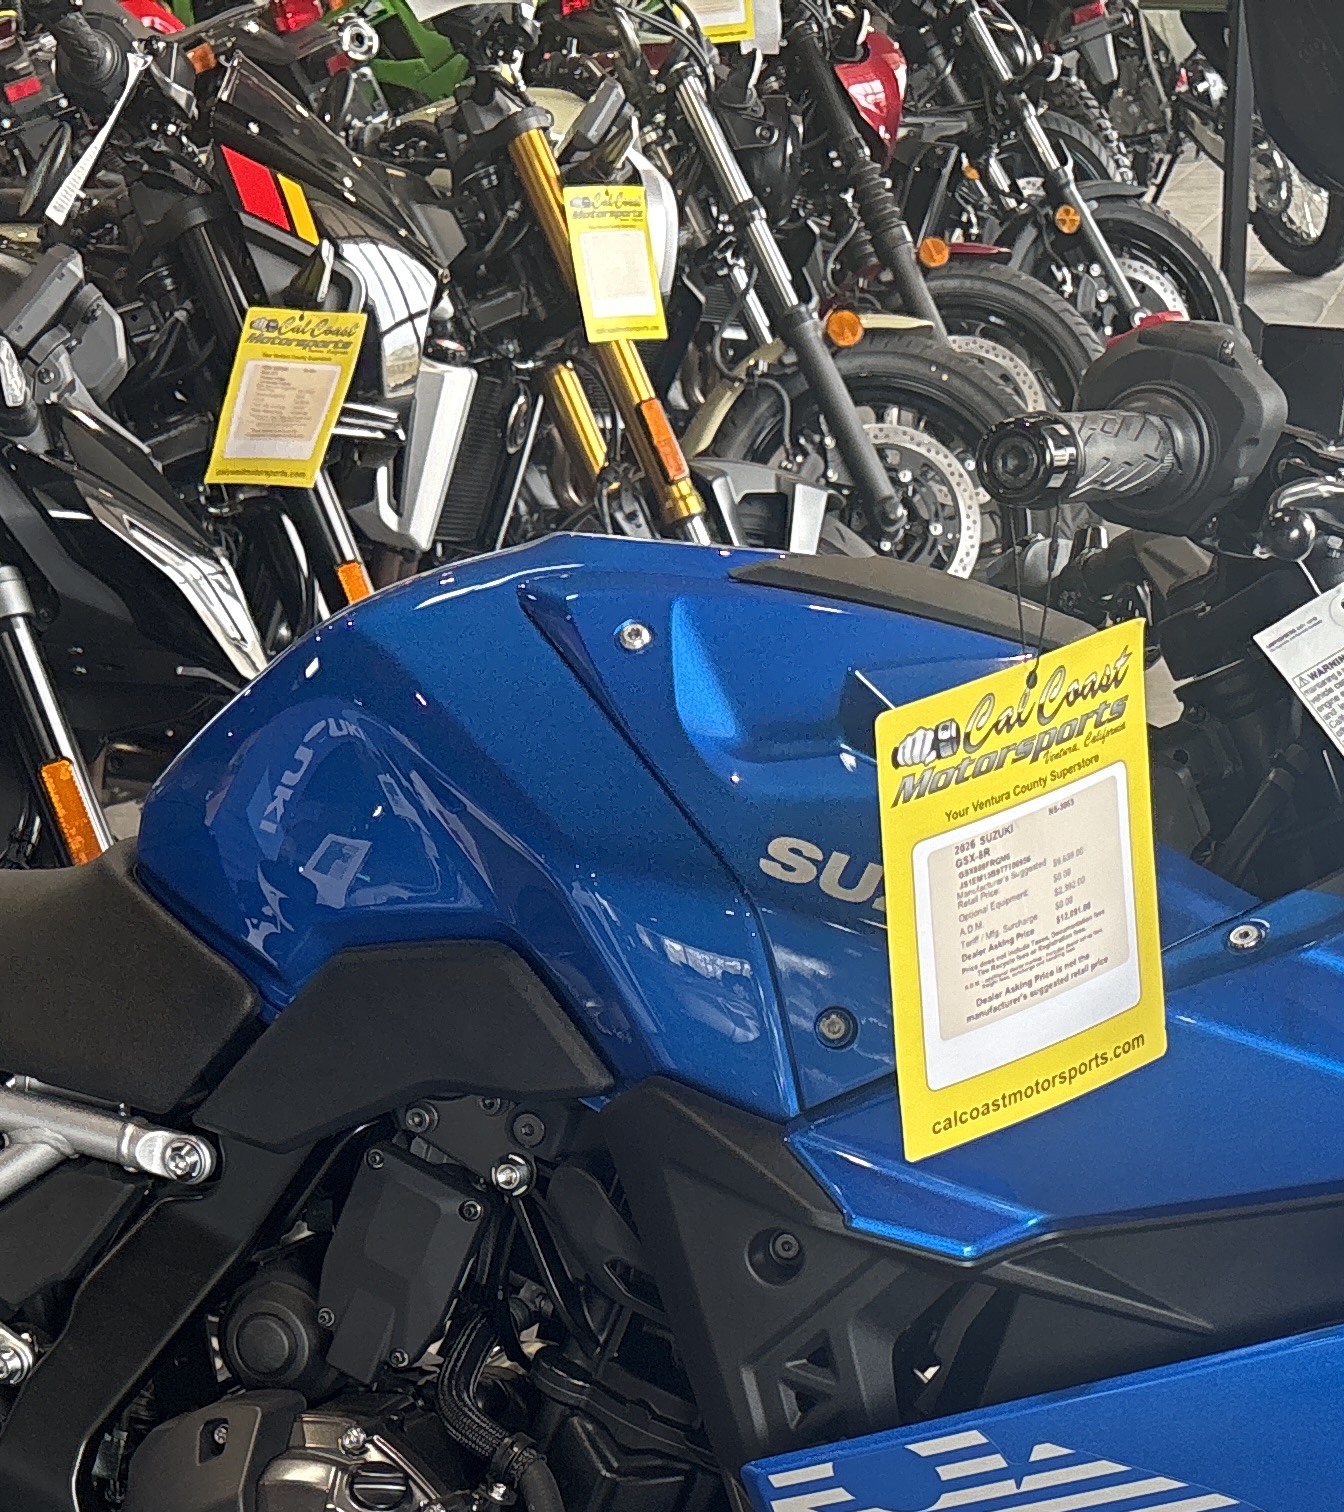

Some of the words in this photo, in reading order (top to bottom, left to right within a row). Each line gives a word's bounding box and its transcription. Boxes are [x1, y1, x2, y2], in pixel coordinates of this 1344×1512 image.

[963, 690, 1035, 755] Cal
[1037, 645, 1133, 727] Coast
[890, 694, 1130, 809] Motorsports
[945, 806, 971, 823] Your
[972, 790, 1011, 813] Ventura
[1013, 775, 1048, 797] County
[1050, 753, 1100, 783] Superstore
[978, 823, 1014, 845] SUZUKI
[759, 836, 886, 912] SU
[1010, 857, 1046, 880] Suggested
[956, 894, 979, 910] Retail
[957, 903, 989, 924] Optional
[960, 945, 986, 963] Dealer
[987, 934, 1014, 954] Asking
[1015, 926, 1034, 941] Price
[1069, 962, 1090, 979] retail
[1089, 954, 1108, 972] price
[975, 988, 1003, 1008] Dealer
[1003, 975, 1033, 997] Asking
[1033, 966, 1054, 983] Price
[1063, 957, 1077, 970] not
[1077, 952, 1089, 965] the
[931, 1033, 1146, 1135] calcoastmotorsports.com
